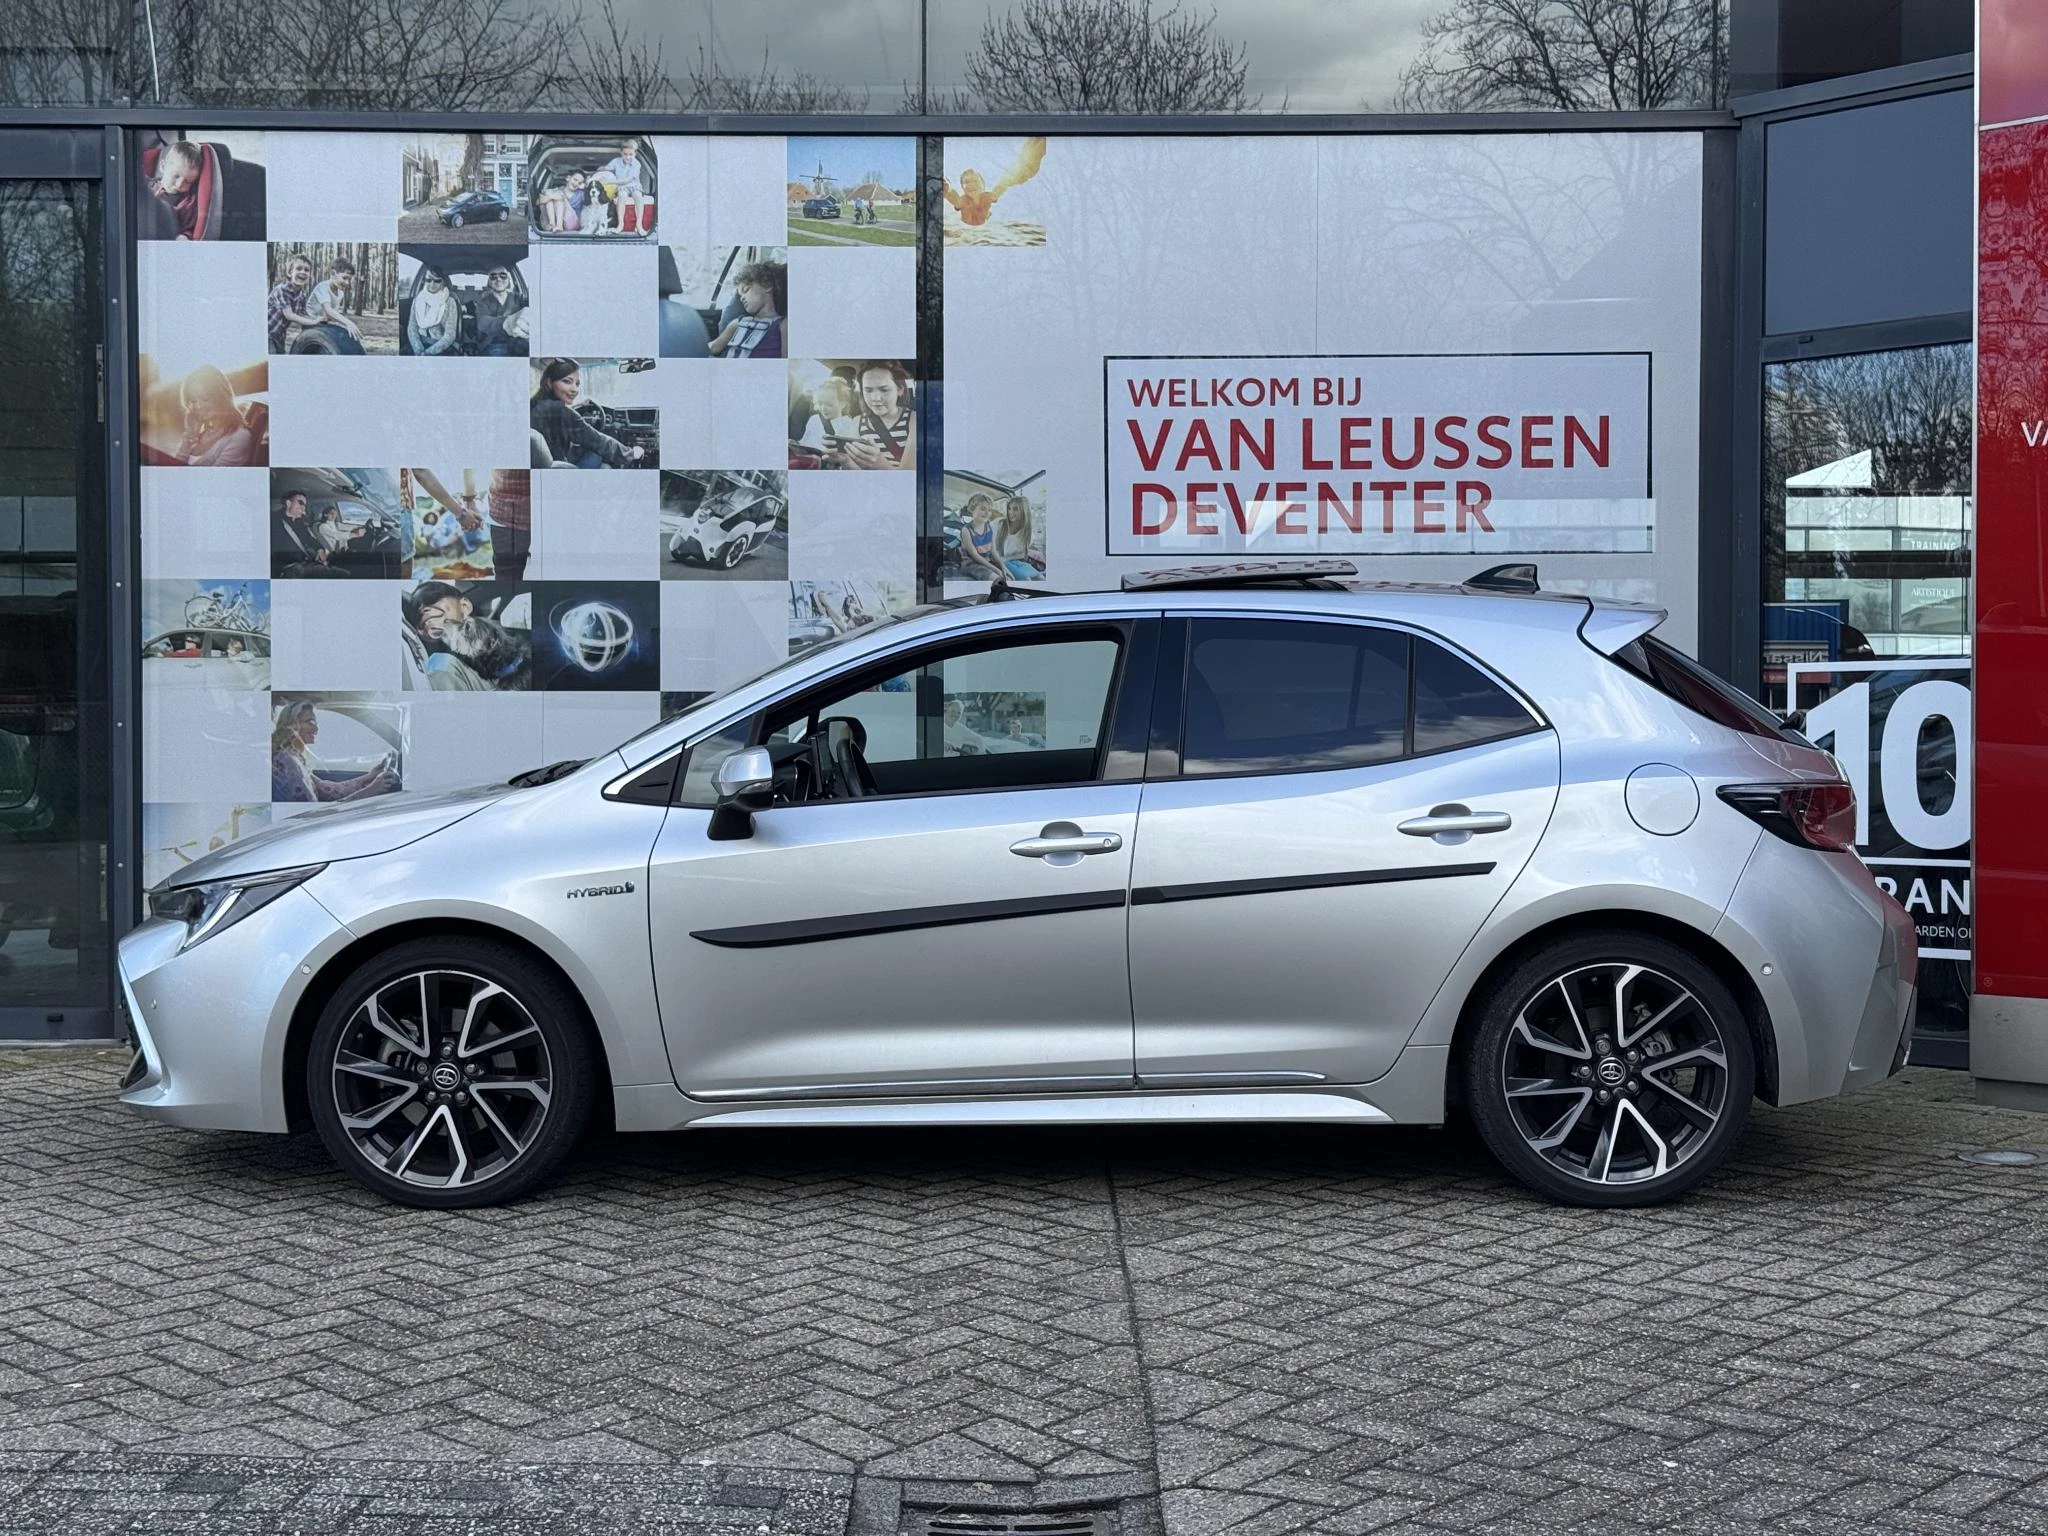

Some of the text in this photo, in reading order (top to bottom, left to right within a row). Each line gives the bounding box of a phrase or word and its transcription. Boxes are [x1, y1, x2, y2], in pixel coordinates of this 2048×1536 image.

[1127, 377, 1362, 407] WELKOM BIJ
[1127, 415, 1610, 471] VAN LEUSSEN
[1132, 480, 1496, 535] DEVENTER
[566, 884, 625, 899] HYBRID
[1957, 927, 1971, 939] O
